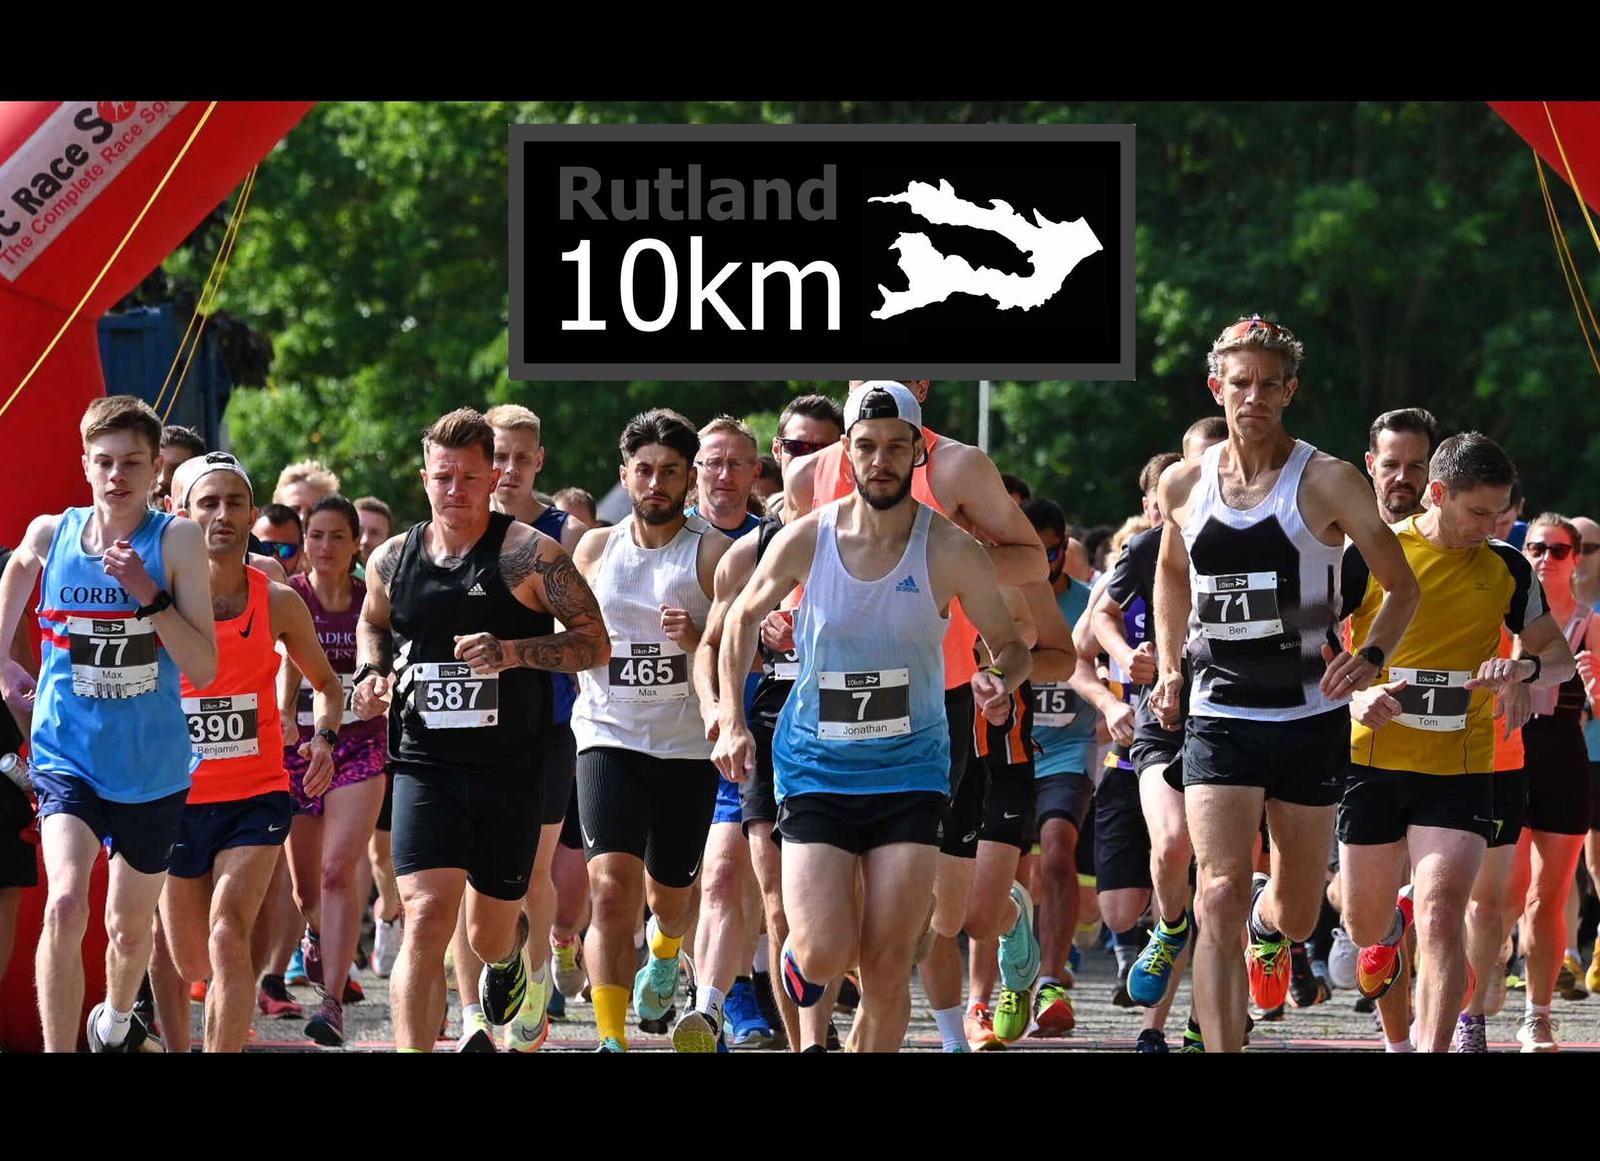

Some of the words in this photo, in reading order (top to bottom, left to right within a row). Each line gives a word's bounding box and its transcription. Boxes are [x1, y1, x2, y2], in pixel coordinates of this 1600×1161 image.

[0, 236, 33, 265] The
[31, 164, 104, 234] Complete
[100, 124, 142, 164] Race
[140, 101, 170, 123] So
[11, 143, 89, 216] Race
[60, 586, 131, 604] CORBY
[1213, 592, 1250, 622] 71
[1229, 626, 1248, 635] Ben
[89, 637, 128, 666] 77
[102, 670, 123, 680] Max
[440, 669, 456, 677] 10km
[620, 658, 674, 685] 465
[426, 681, 483, 711] 587
[638, 688, 658, 697] Max
[1036, 690, 1066, 713] 15
[1422, 687, 1436, 714] 1
[852, 691, 872, 721] 7
[187, 713, 244, 743] 390
[842, 724, 888, 736] Jonathan
[1419, 717, 1438, 727] Tom
[197, 744, 239, 756] Benjamin
